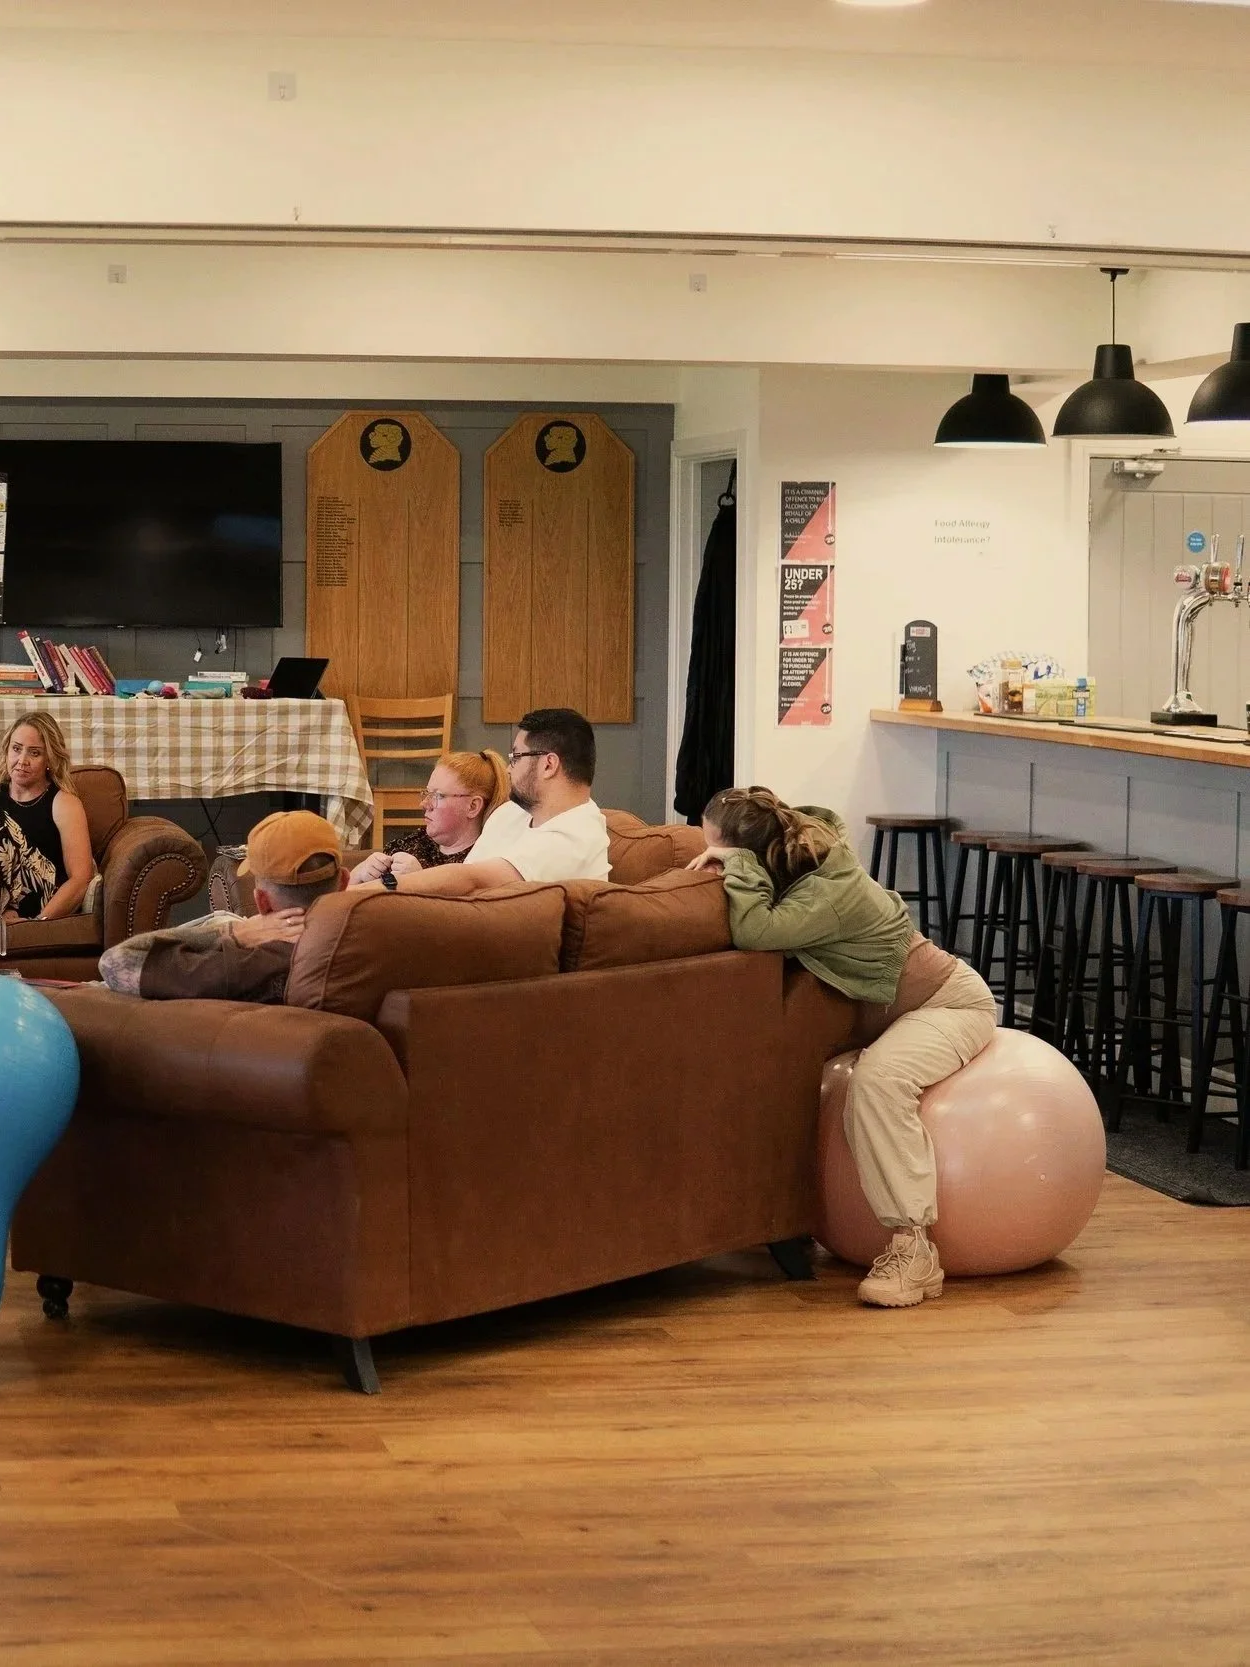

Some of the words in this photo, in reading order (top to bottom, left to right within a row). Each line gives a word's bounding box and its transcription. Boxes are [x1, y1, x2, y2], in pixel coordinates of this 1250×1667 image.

[958, 519, 991, 529] Allergy
[785, 568, 823, 580] UNDER
[784, 579, 803, 590] 25?
